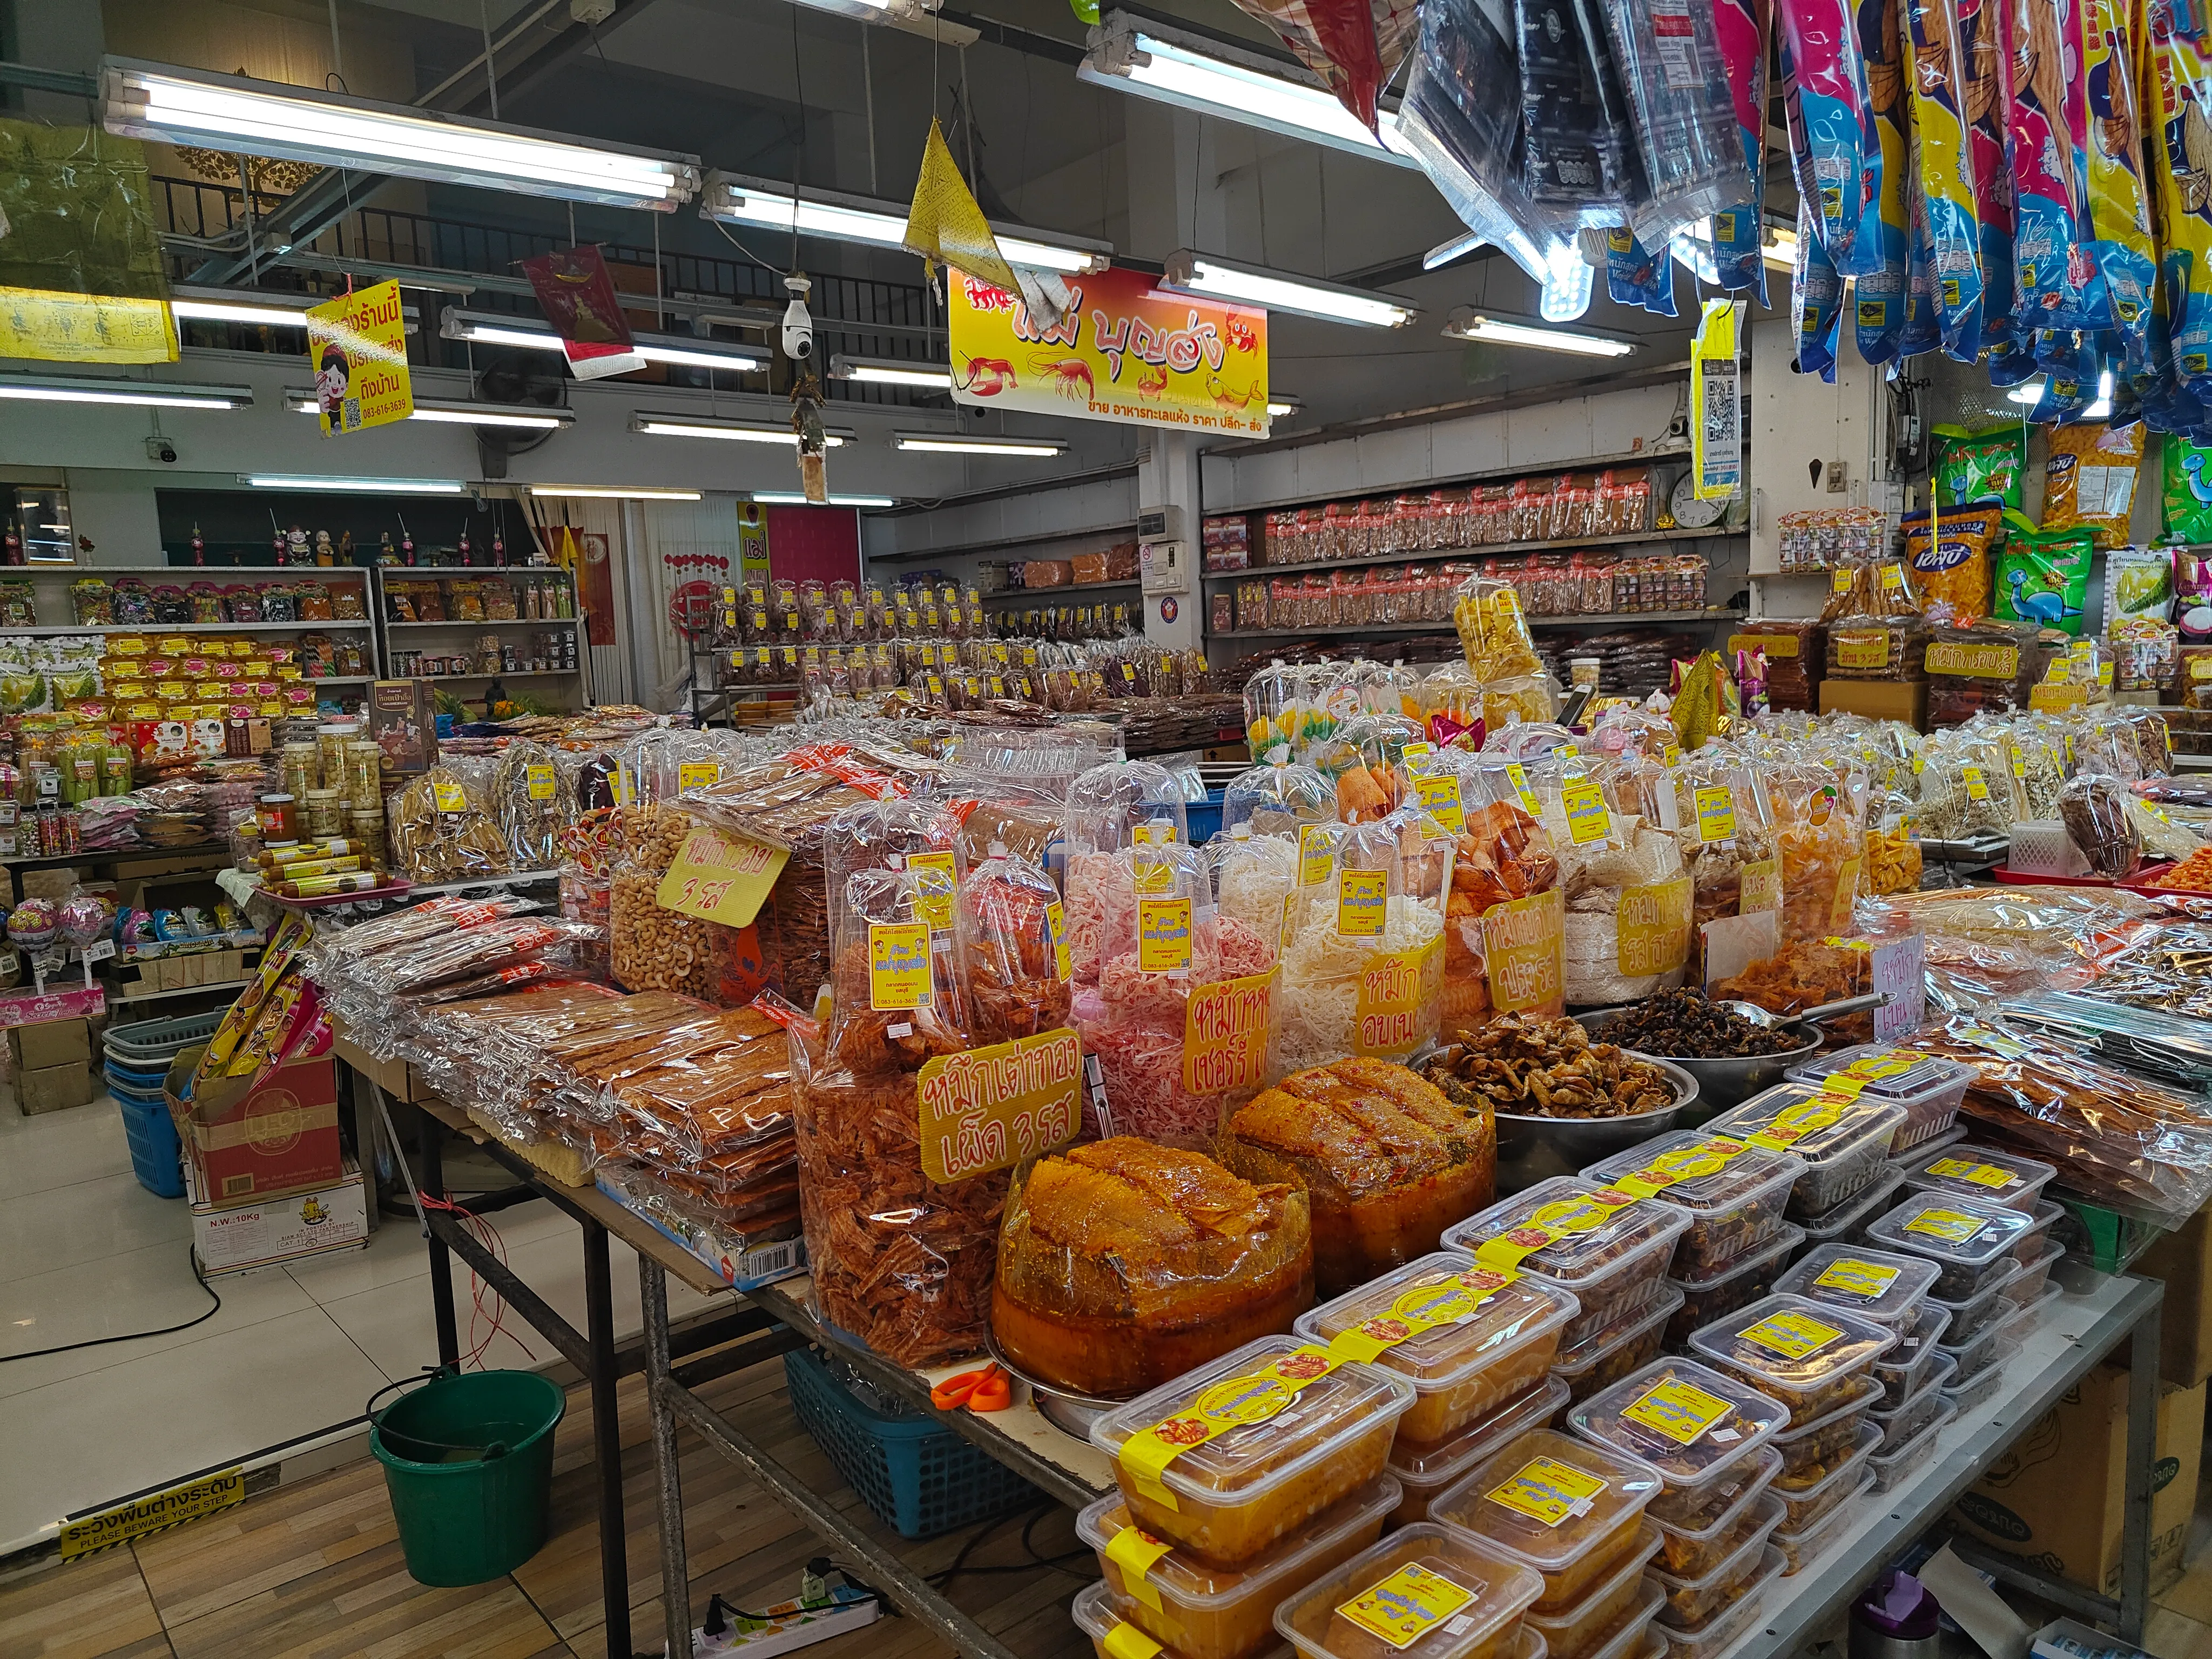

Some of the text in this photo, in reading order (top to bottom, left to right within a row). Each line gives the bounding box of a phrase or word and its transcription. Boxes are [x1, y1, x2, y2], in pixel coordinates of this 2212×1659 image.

[361, 373, 400, 400] ถึงบ้าน
[363, 399, 406, 419] 083-616-3639
[1088, 400, 1110, 415] ขาย
[1114, 403, 1190, 425] อาหารทะเลแห้ง
[1193, 415, 1217, 428] ราคา
[1250, 416, 1263, 433] ส่ง
[1676, 490, 1685, 499] 10
[1675, 502, 1682, 511] 9
[1680, 512, 1686, 520] 8
[1700, 516, 1707, 524] 6
[1916, 545, 1966, 569] เอสบี
[1928, 645, 2012, 670] หมึกกรอบ 3
[675, 878, 699, 908] 3
[1158, 916, 1175, 926] ร้าน
[1144, 925, 1189, 943] แม่บุญส่ง
[890, 944, 909, 955] ร้าน
[876, 953, 927, 975] แม่บุญส่ง
[922, 1036, 1079, 1120] หมึกเต่าทอง
[942, 1091, 1075, 1178] เผ็ด 3 รส
[319, 1222, 354, 1232] PARTNERSHIP
[69, 1476, 237, 1541] ระวังพื้นต่างระดับ
[80, 1494, 228, 1549] PLEASE BEWARE YOUR STEP
